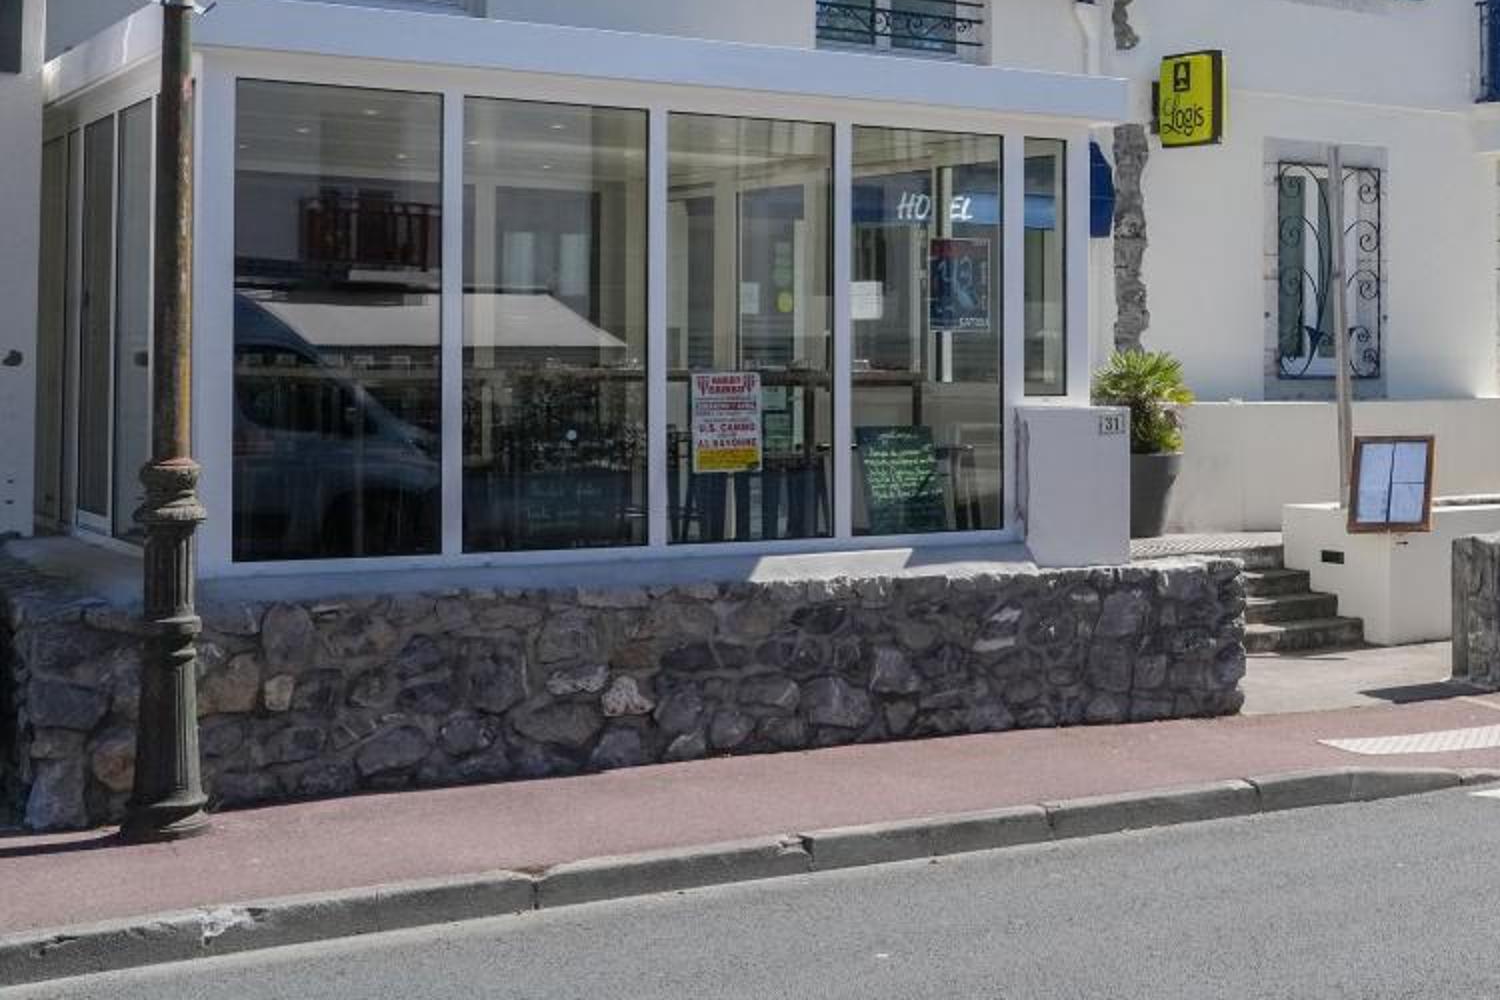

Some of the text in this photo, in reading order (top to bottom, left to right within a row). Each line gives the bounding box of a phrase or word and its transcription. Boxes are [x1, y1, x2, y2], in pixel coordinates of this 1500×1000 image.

[1161, 97, 1205, 137] Logis
[897, 192, 973, 220] HOEL
[1105, 415, 1119, 431] 31
